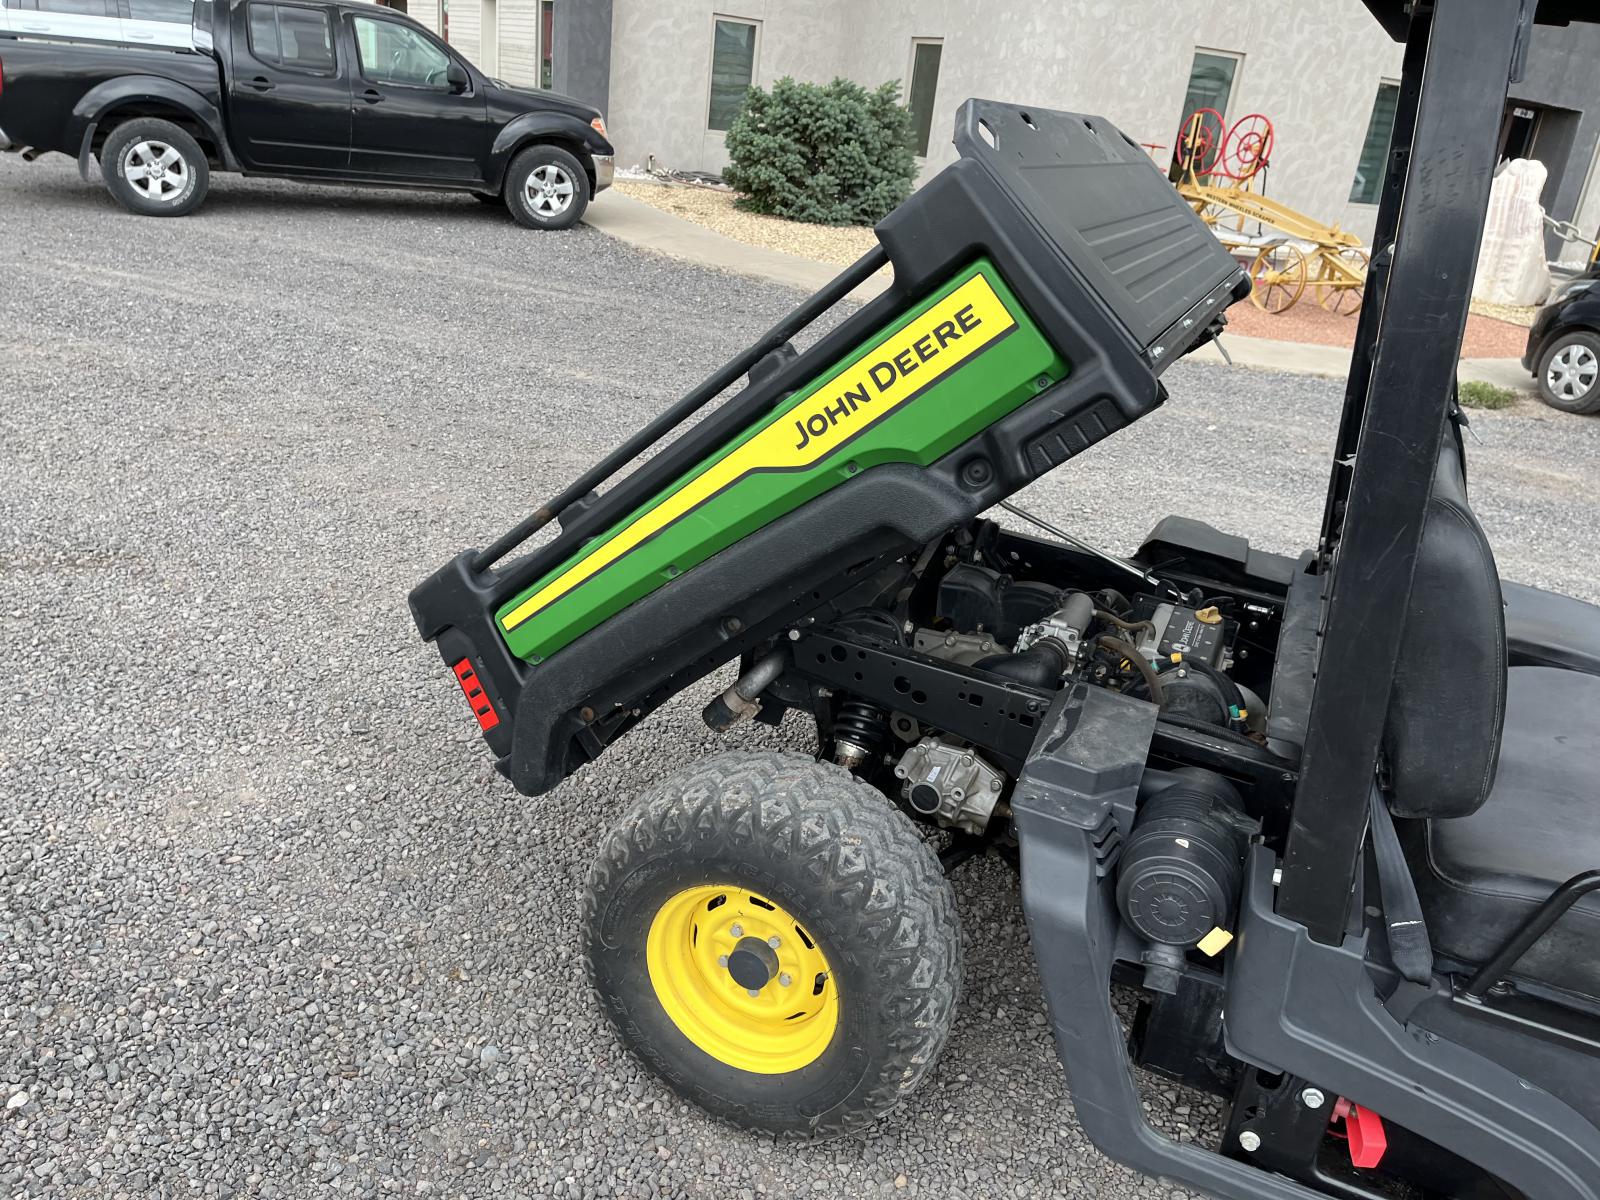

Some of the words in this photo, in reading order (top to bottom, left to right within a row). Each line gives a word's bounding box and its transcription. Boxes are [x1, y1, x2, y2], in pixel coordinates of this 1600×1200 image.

[1252, 211, 1275, 224] SCRAPER
[795, 383, 871, 449] JOHN
[868, 304, 982, 392] DEERE
[1182, 620, 1195, 635] DEERE
[1179, 631, 1191, 645] JOHN
